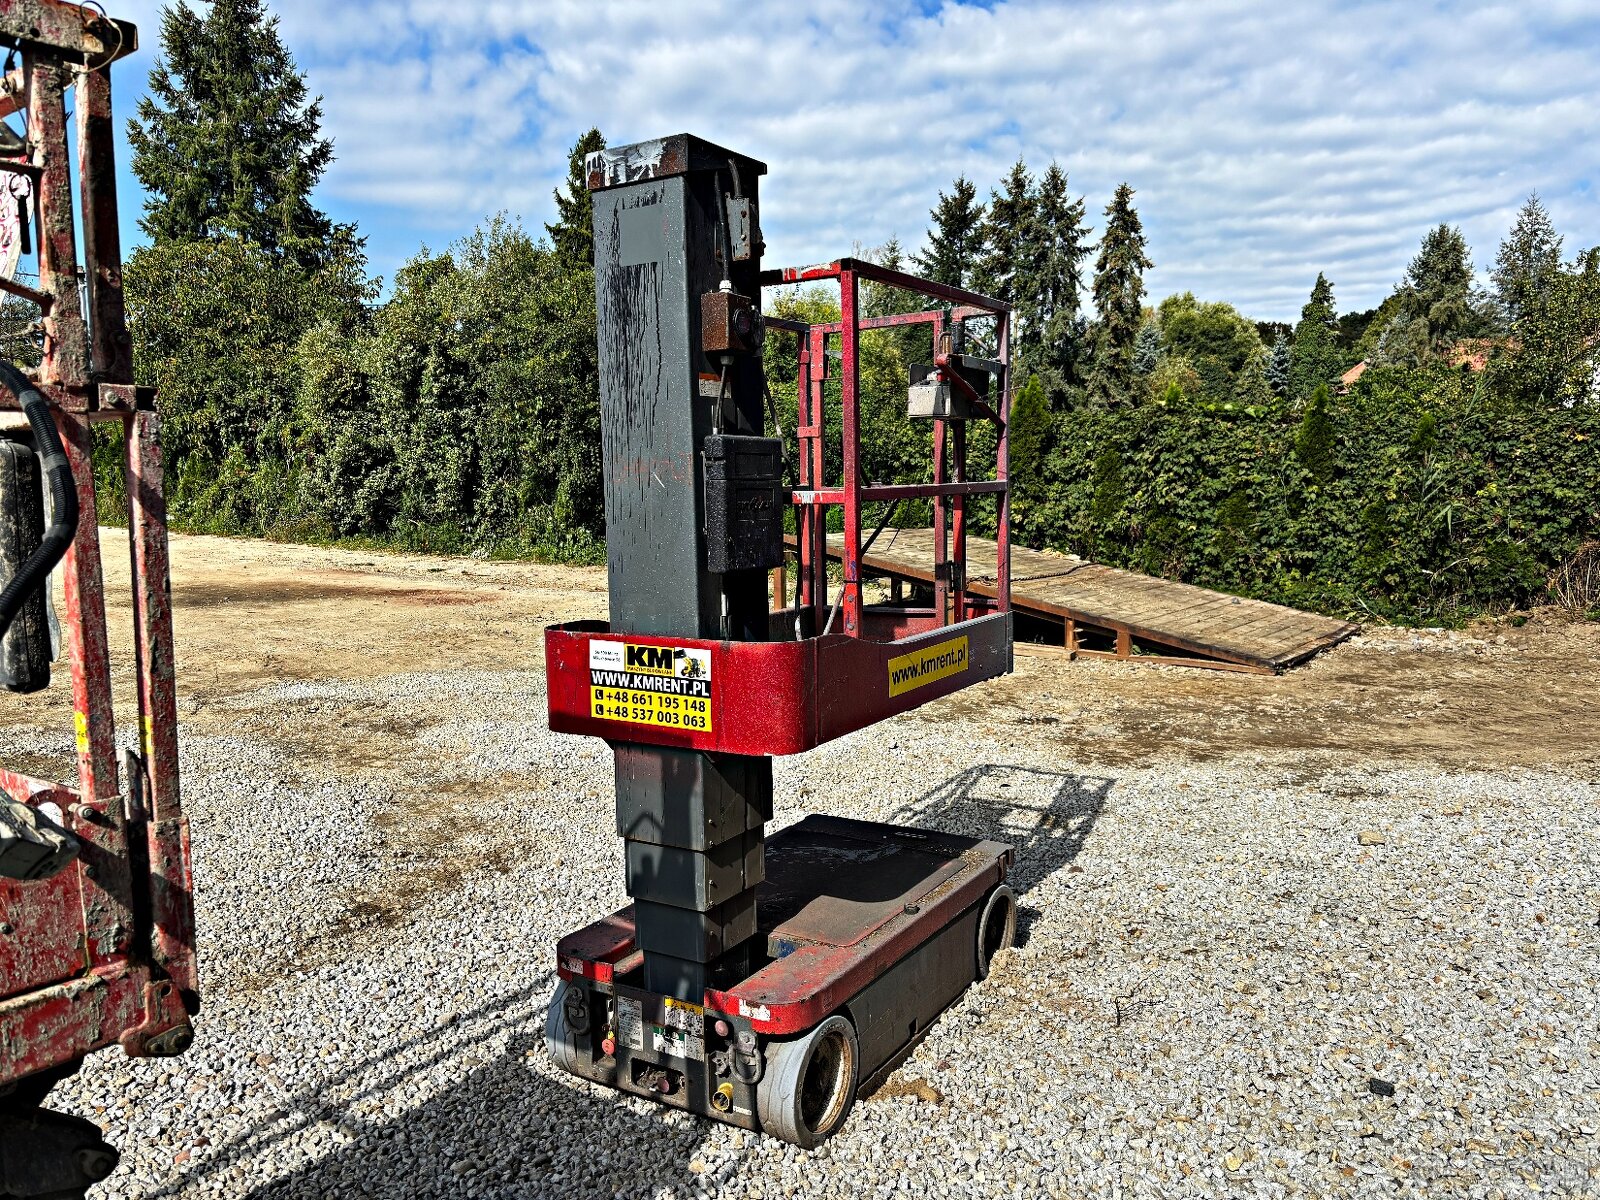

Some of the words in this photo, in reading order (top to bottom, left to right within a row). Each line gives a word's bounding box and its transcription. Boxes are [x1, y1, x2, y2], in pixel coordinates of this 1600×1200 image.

[627, 645, 672, 669] KM
[892, 644, 965, 685] www.kmrent.pl
[591, 671, 709, 697] WWW.KMRENT.PL
[606, 691, 628, 703] +48
[632, 693, 652, 706] 661
[658, 696, 679, 709] 195
[684, 699, 705, 712] 148
[606, 706, 628, 718] +48
[632, 708, 653, 721] 537
[657, 711, 679, 724] 003
[683, 714, 705, 728] 063
